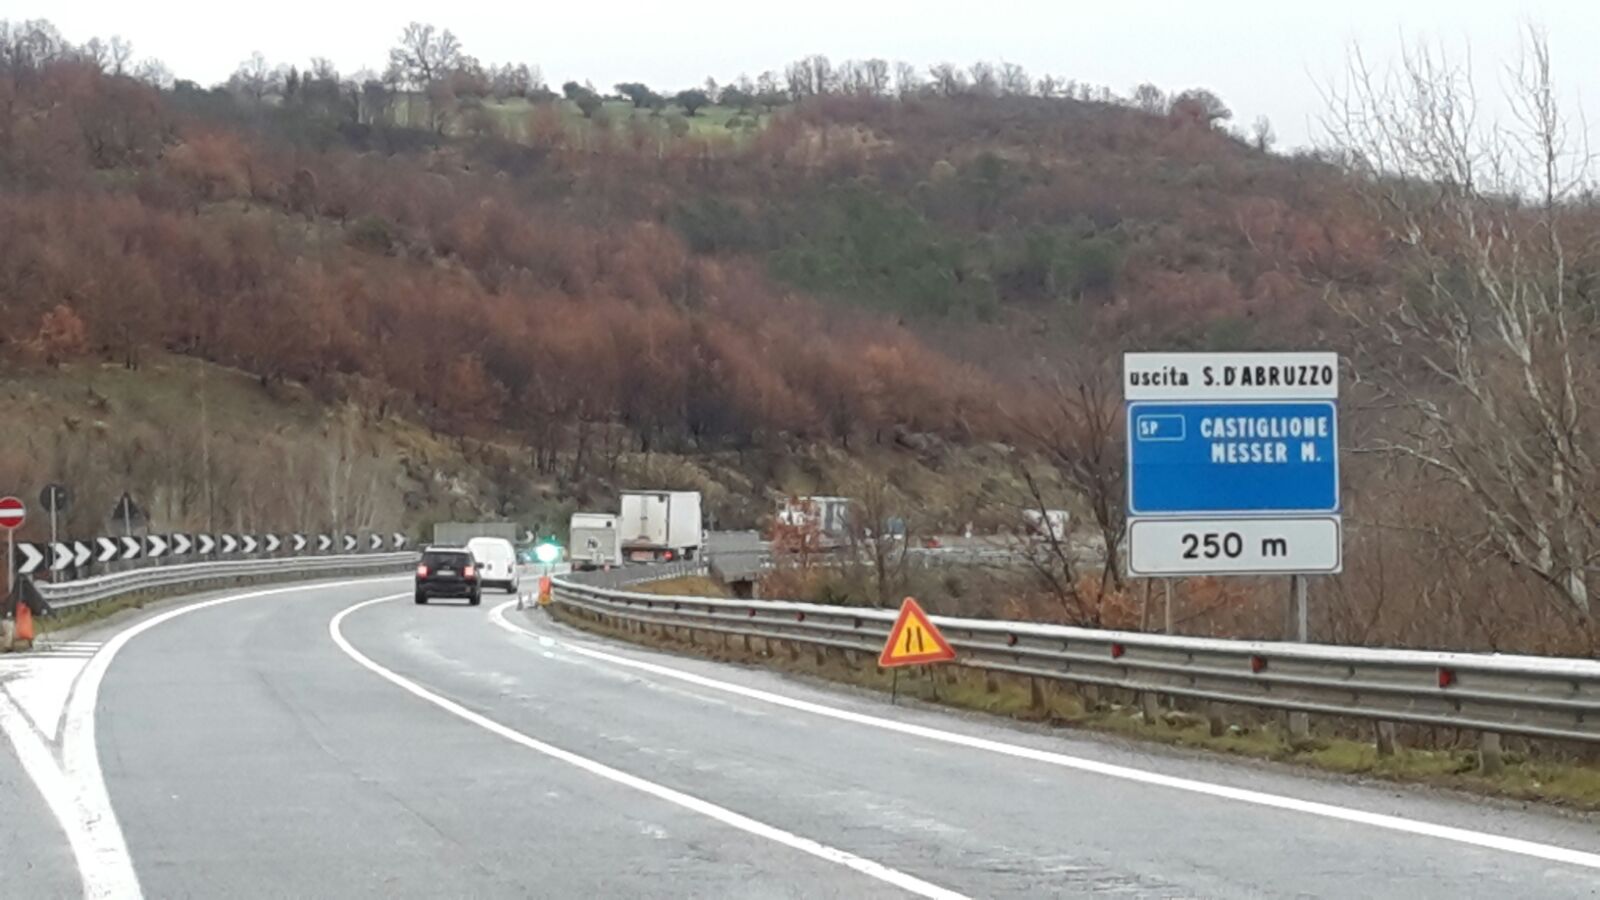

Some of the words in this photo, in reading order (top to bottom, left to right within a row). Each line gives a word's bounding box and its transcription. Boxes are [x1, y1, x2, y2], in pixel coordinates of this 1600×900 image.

[1130, 366, 1189, 386] uscita
[1140, 421, 1158, 435] SP
[1200, 417, 1328, 438] CASTIGLIONE
[1211, 443, 1288, 463] MESSER
[1301, 442, 1322, 462] M.
[1181, 532, 1243, 559] 250
[1261, 537, 1288, 557] m
